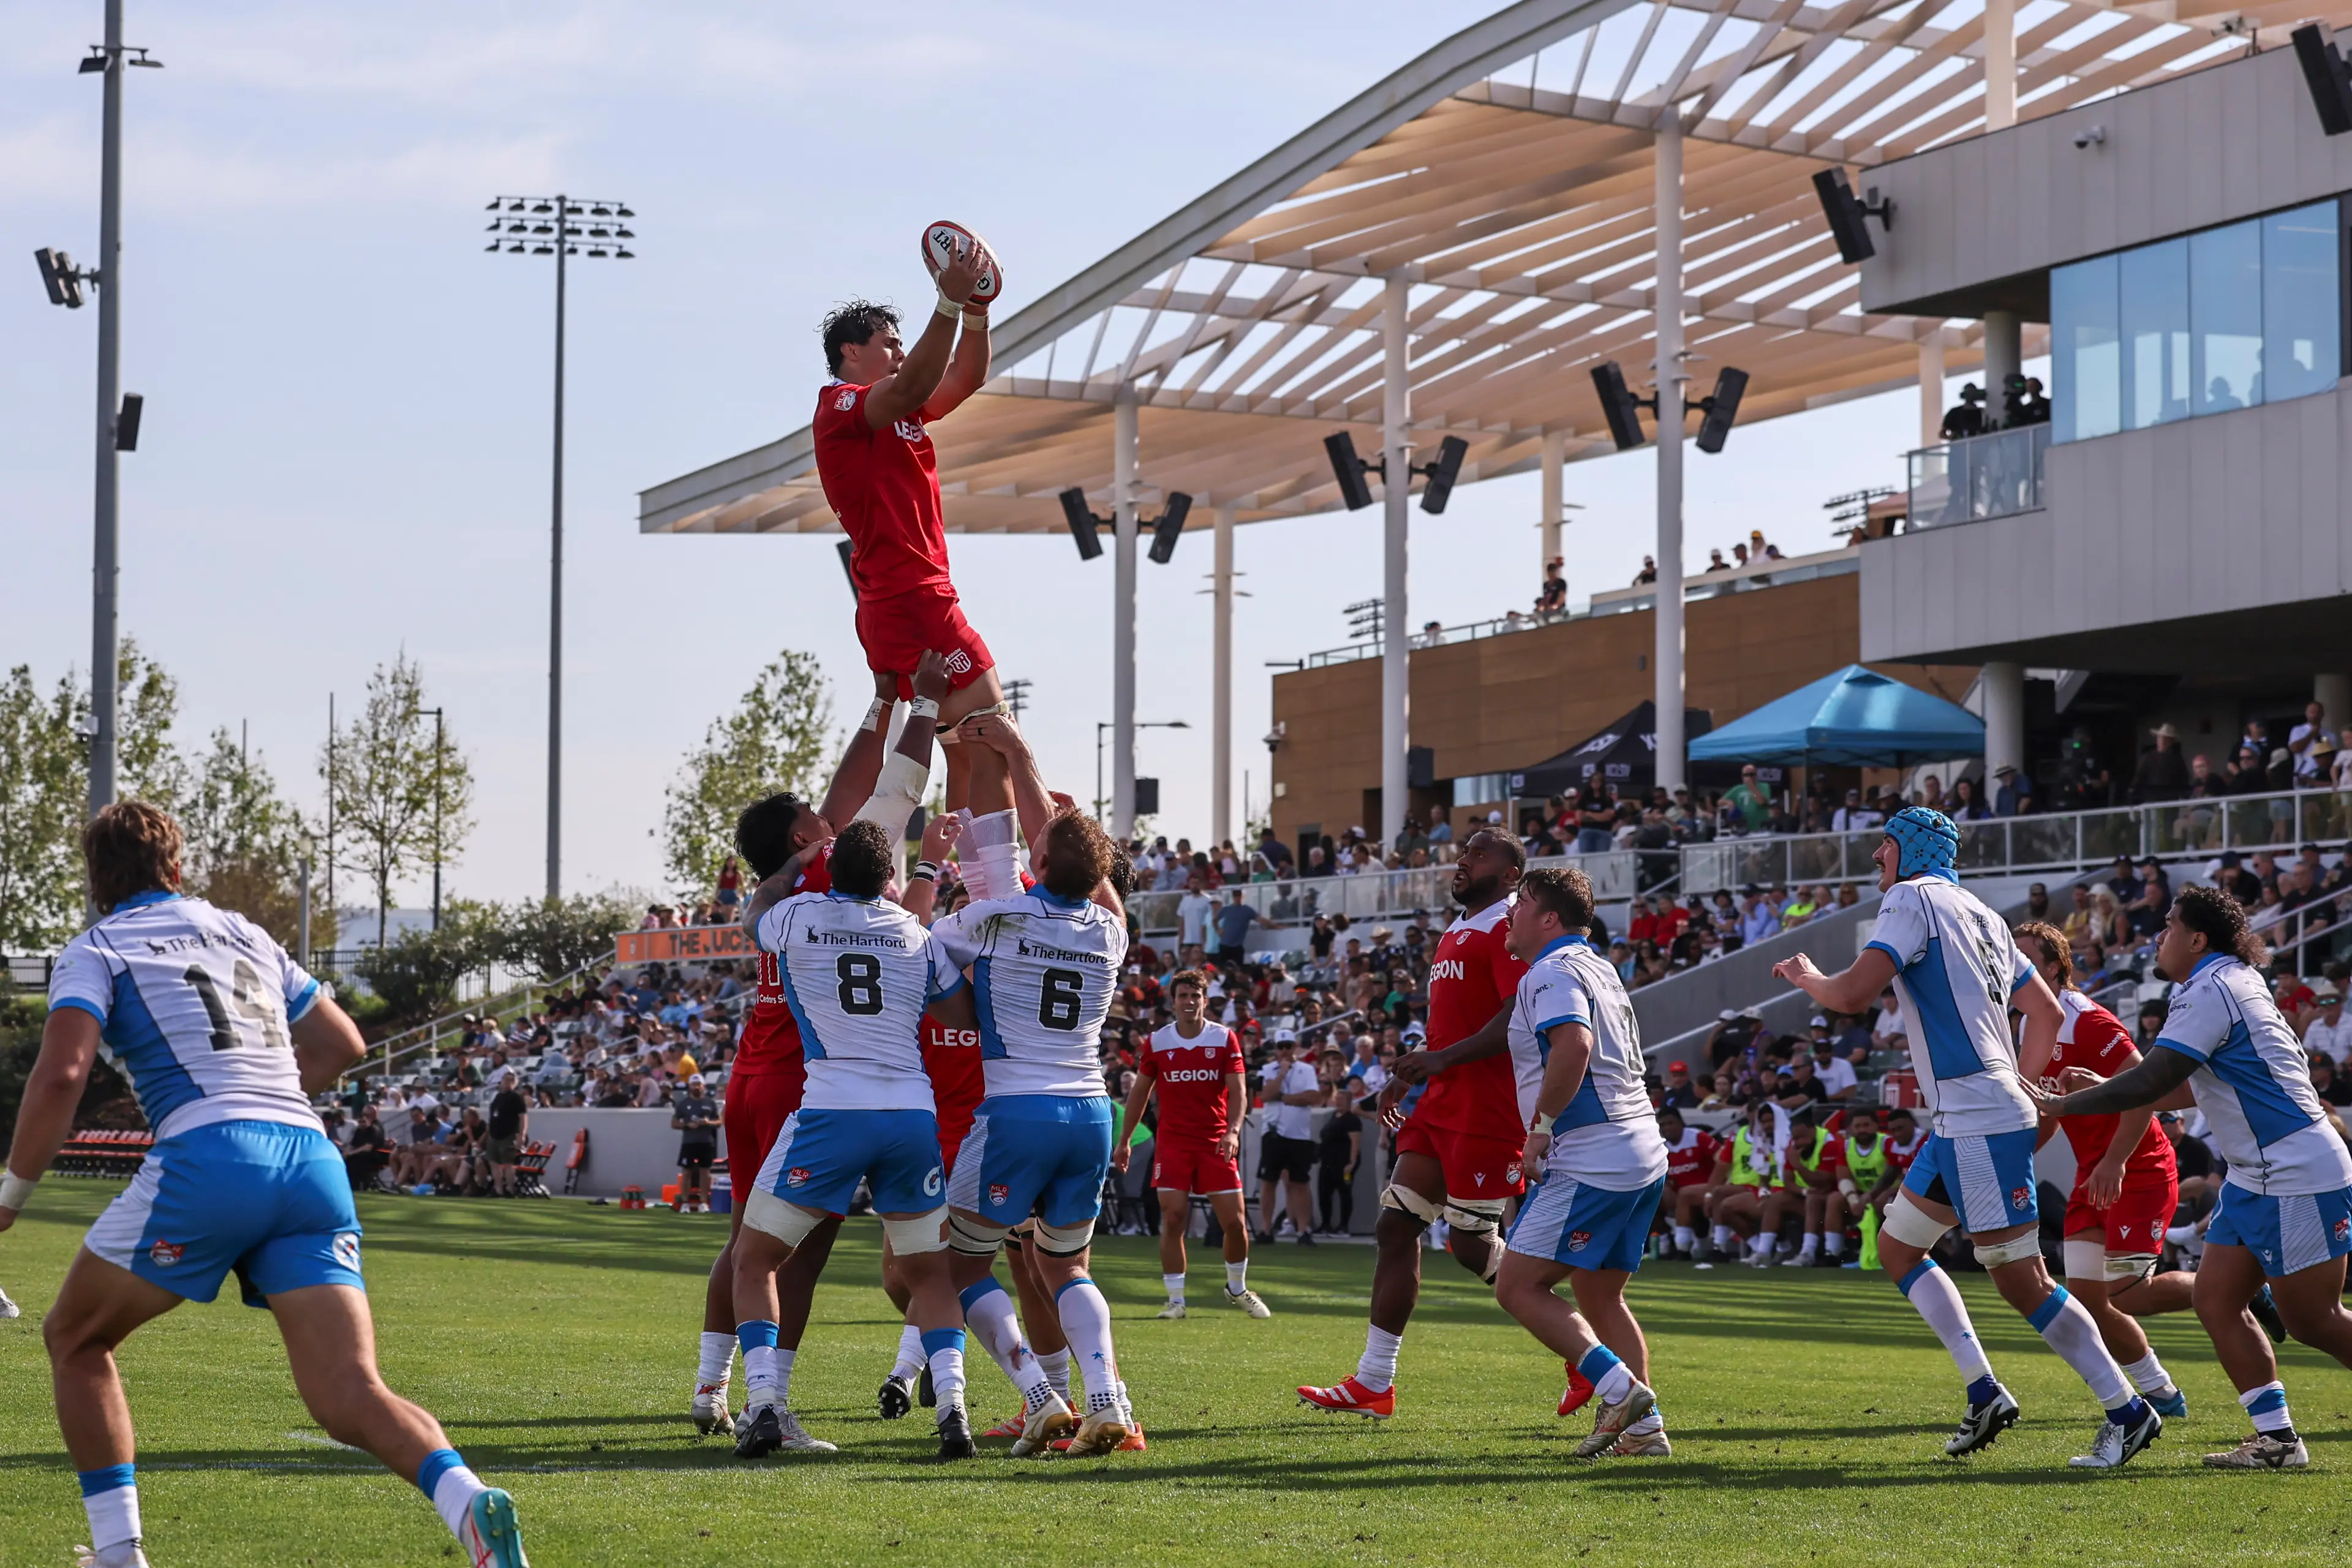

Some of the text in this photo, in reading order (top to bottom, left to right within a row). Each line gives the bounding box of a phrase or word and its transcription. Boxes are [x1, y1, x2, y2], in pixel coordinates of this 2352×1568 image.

[836, 391, 848, 407] MLR
[948, 647, 962, 660] EGION
[164, 937, 199, 952] The
[821, 933, 907, 948] The Hartford
[1032, 945, 1055, 959] The
[1430, 959, 1464, 983] EGION
[835, 952, 884, 1017] 8
[183, 958, 287, 1052] 14
[760, 994, 777, 1004] Cedars
[1038, 968, 1084, 1031] 6
[2100, 1033, 2122, 1057] Globant
[1163, 1069, 1219, 1082] LEGION
[792, 1167, 809, 1178] MLR
[990, 1185, 1008, 1194] MLR
[2013, 1188, 2027, 1198] MLR
[1572, 1232, 1589, 1240] MLR
